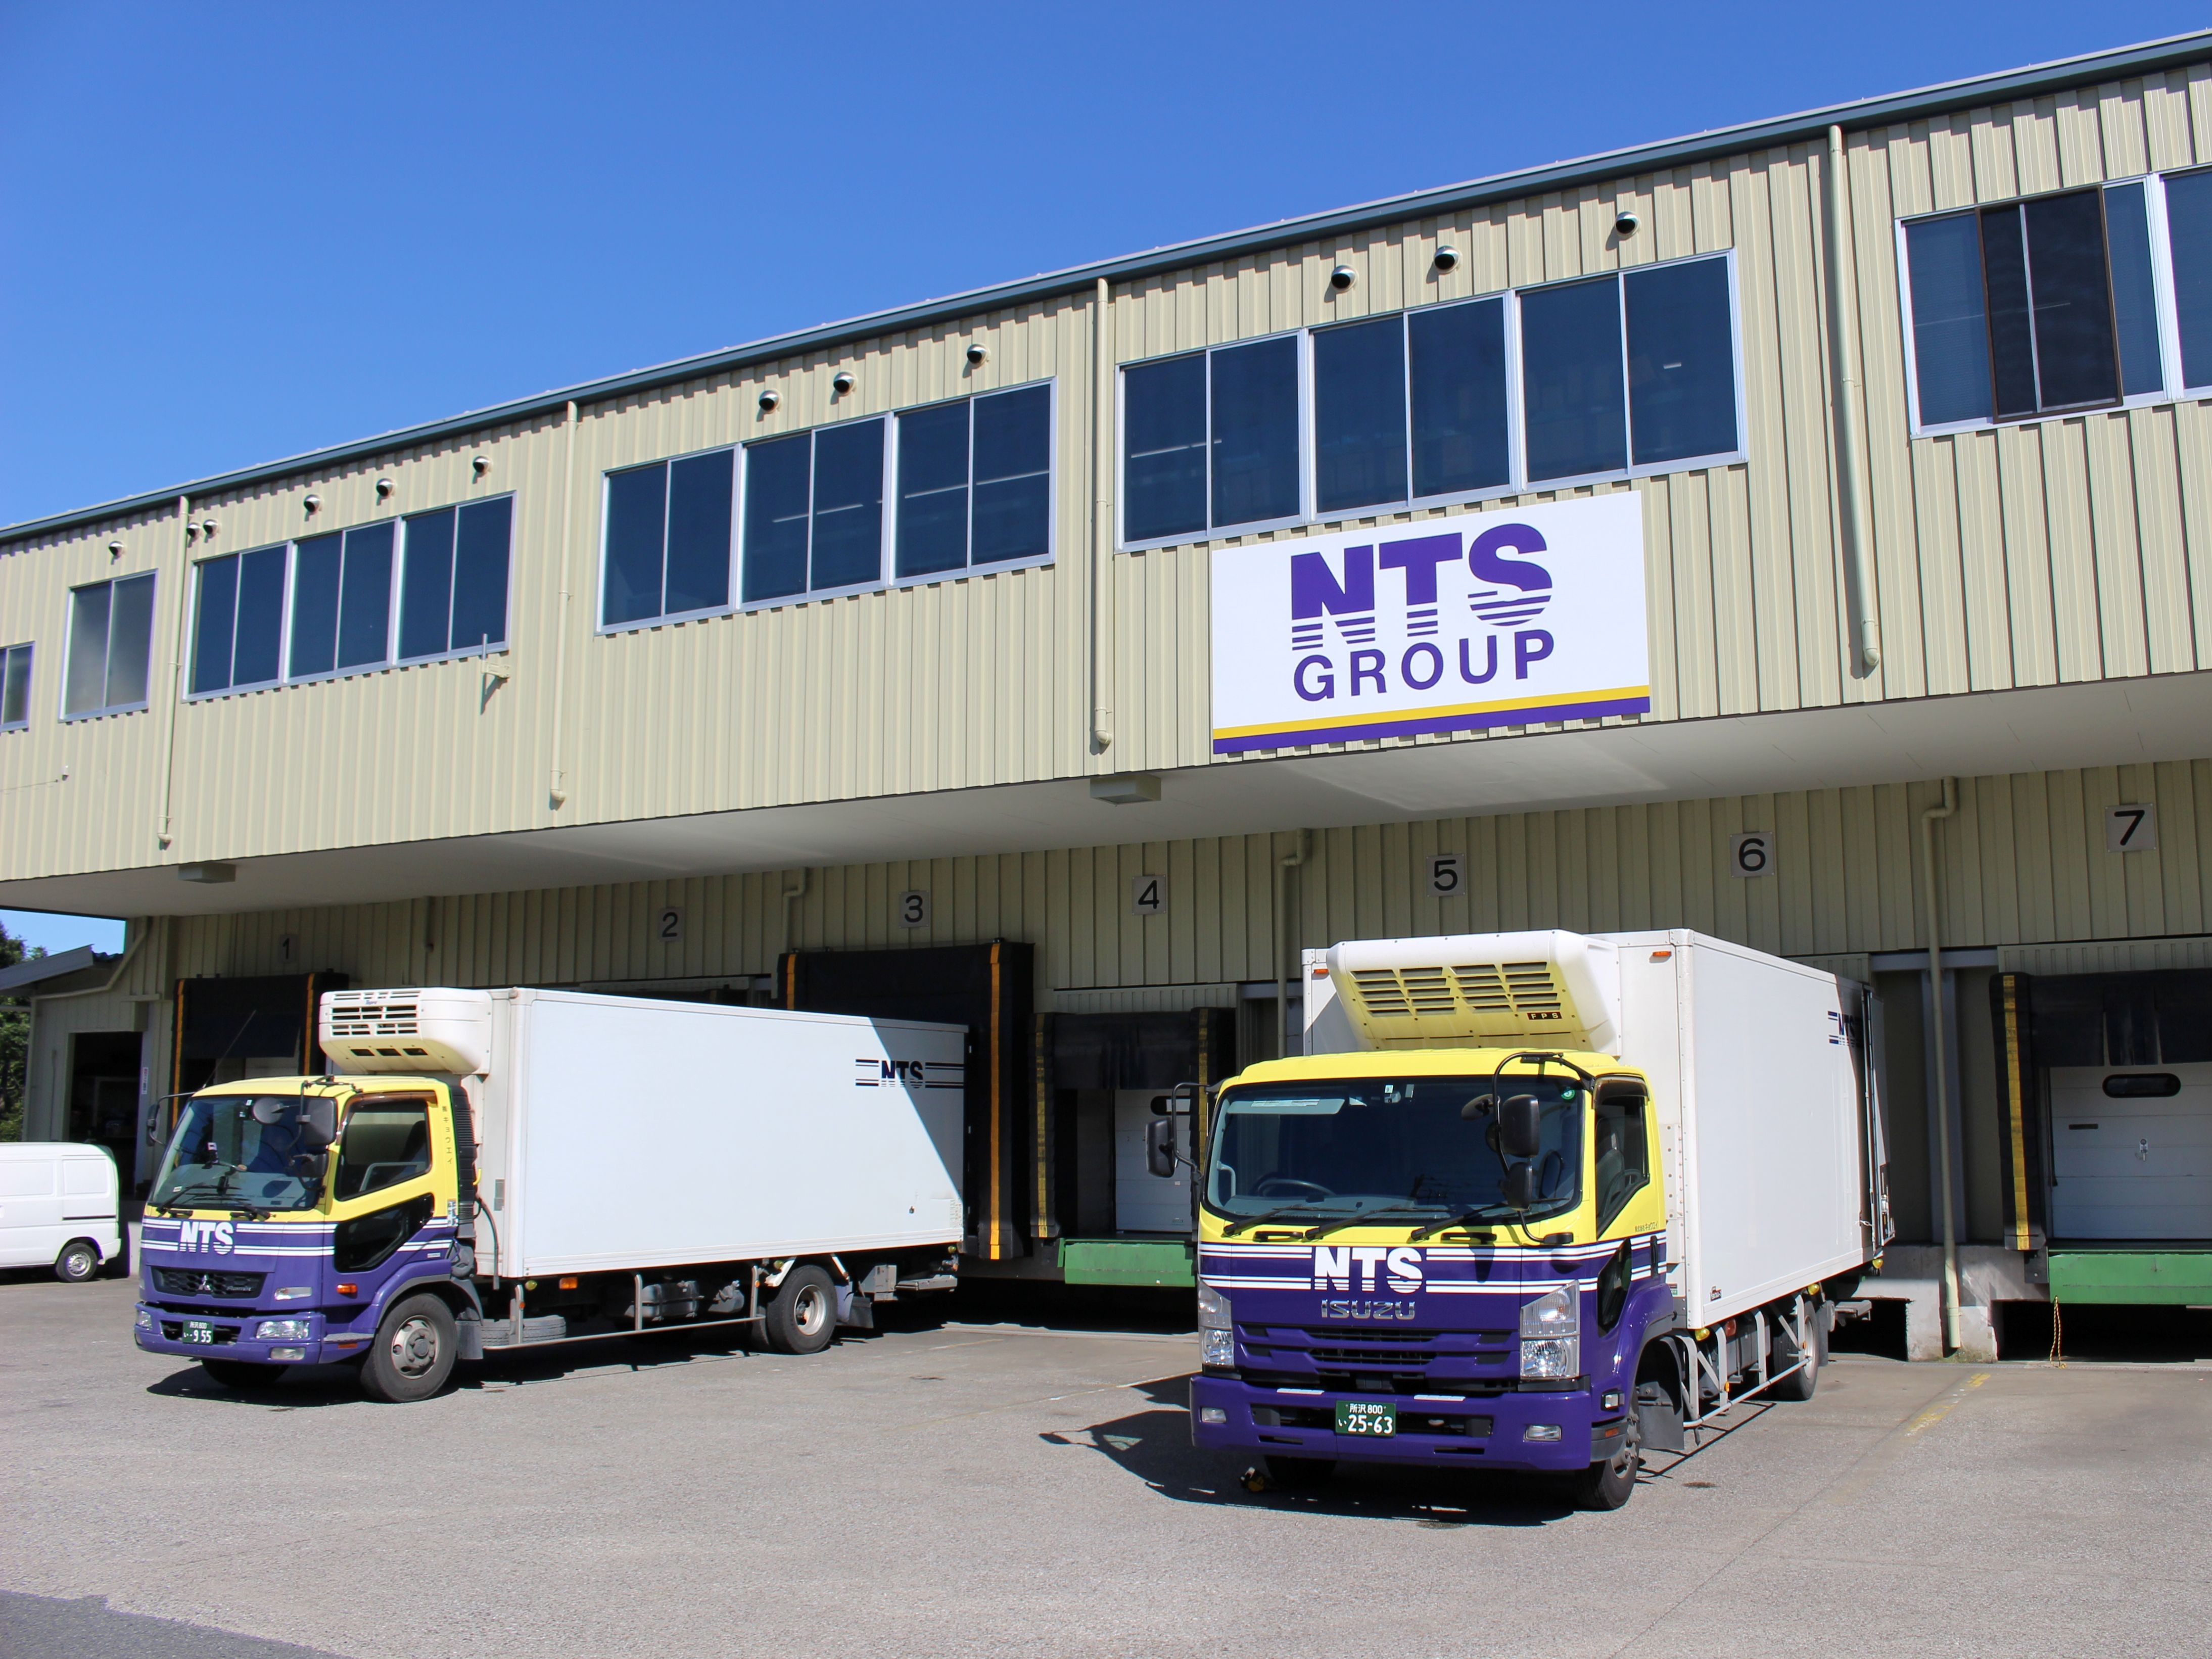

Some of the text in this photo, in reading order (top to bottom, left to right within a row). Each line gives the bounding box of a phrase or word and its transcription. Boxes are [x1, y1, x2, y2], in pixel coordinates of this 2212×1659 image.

[1291, 523, 1552, 650] NTS
[1294, 629, 1554, 701] GROUP
[2114, 810, 2145, 845] 7
[1739, 838, 1766, 872] 6
[1434, 860, 1457, 891] 5
[905, 895, 923, 923] 3
[1138, 880, 1159, 909] 4
[662, 912, 678, 937] 2
[283, 937, 290, 960] 1
[881, 1060, 923, 1088] NTS
[179, 1221, 233, 1255] NTS
[1314, 1247, 1423, 1294] NTS
[1322, 1299, 1415, 1320] ISUZU
[1349, 1403, 1383, 1414] 所沢 800
[1338, 1414, 1392, 1434] い 25-63
